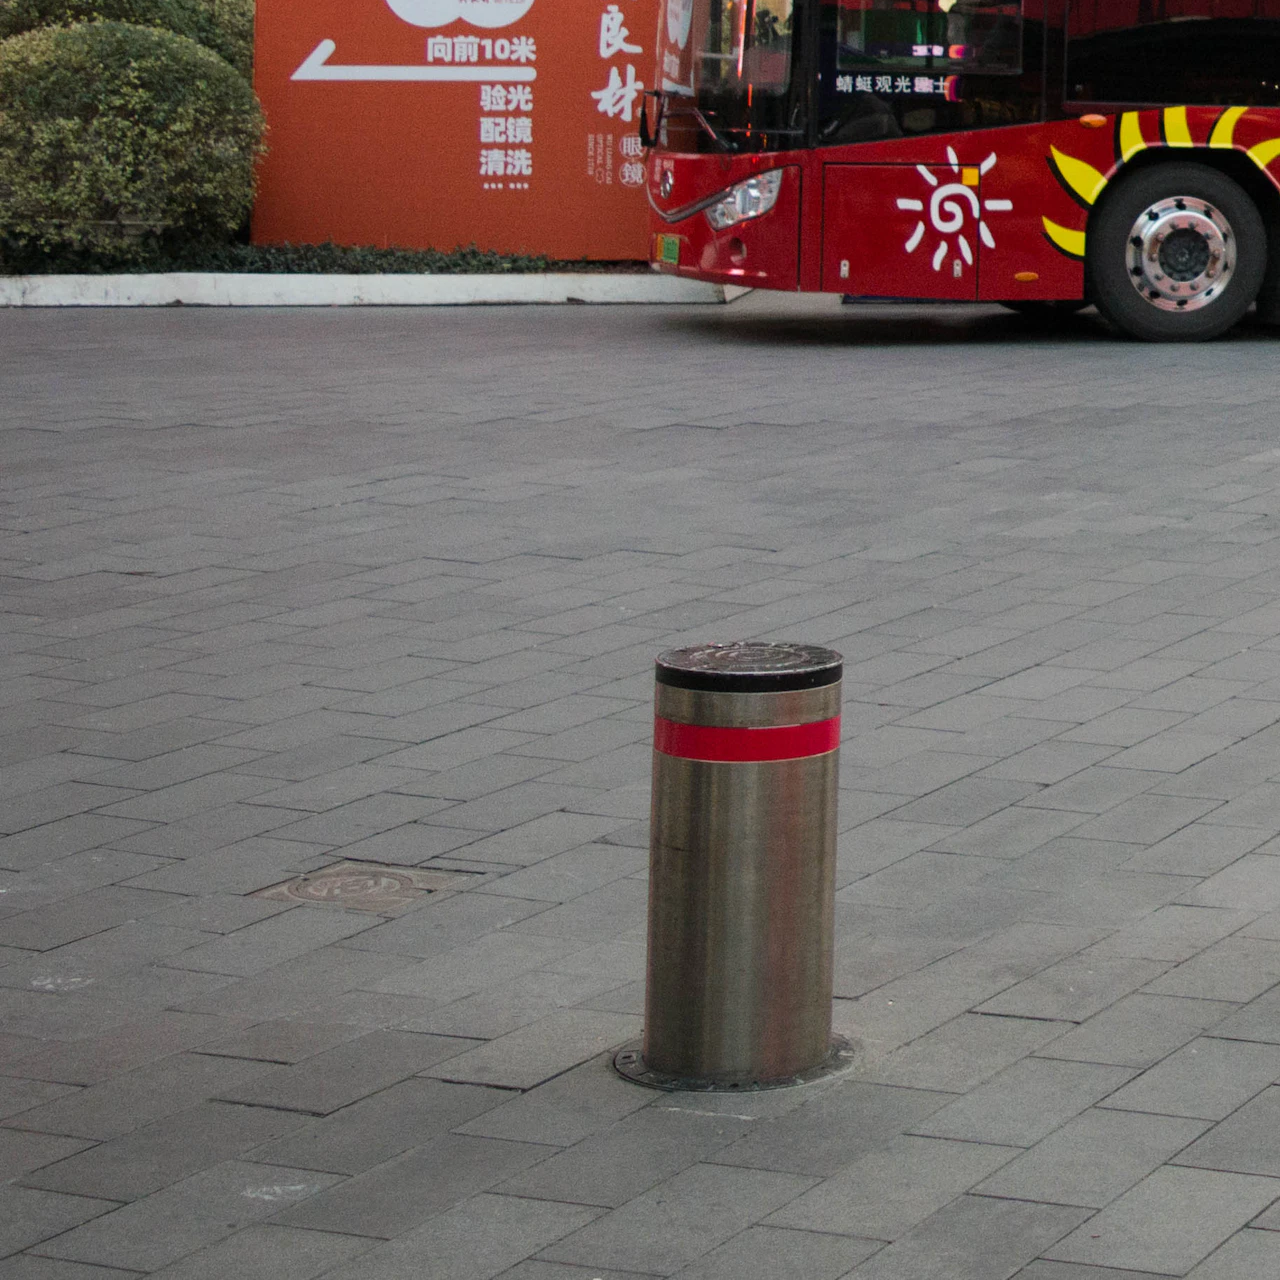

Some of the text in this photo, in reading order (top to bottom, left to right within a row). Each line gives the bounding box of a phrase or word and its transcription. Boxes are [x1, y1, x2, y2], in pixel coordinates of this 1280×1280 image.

[427, 35, 537, 63] 向前10米
[480, 84, 534, 111] 验光
[480, 116, 533, 143] 配镜
[479, 148, 533, 176] 清洗
